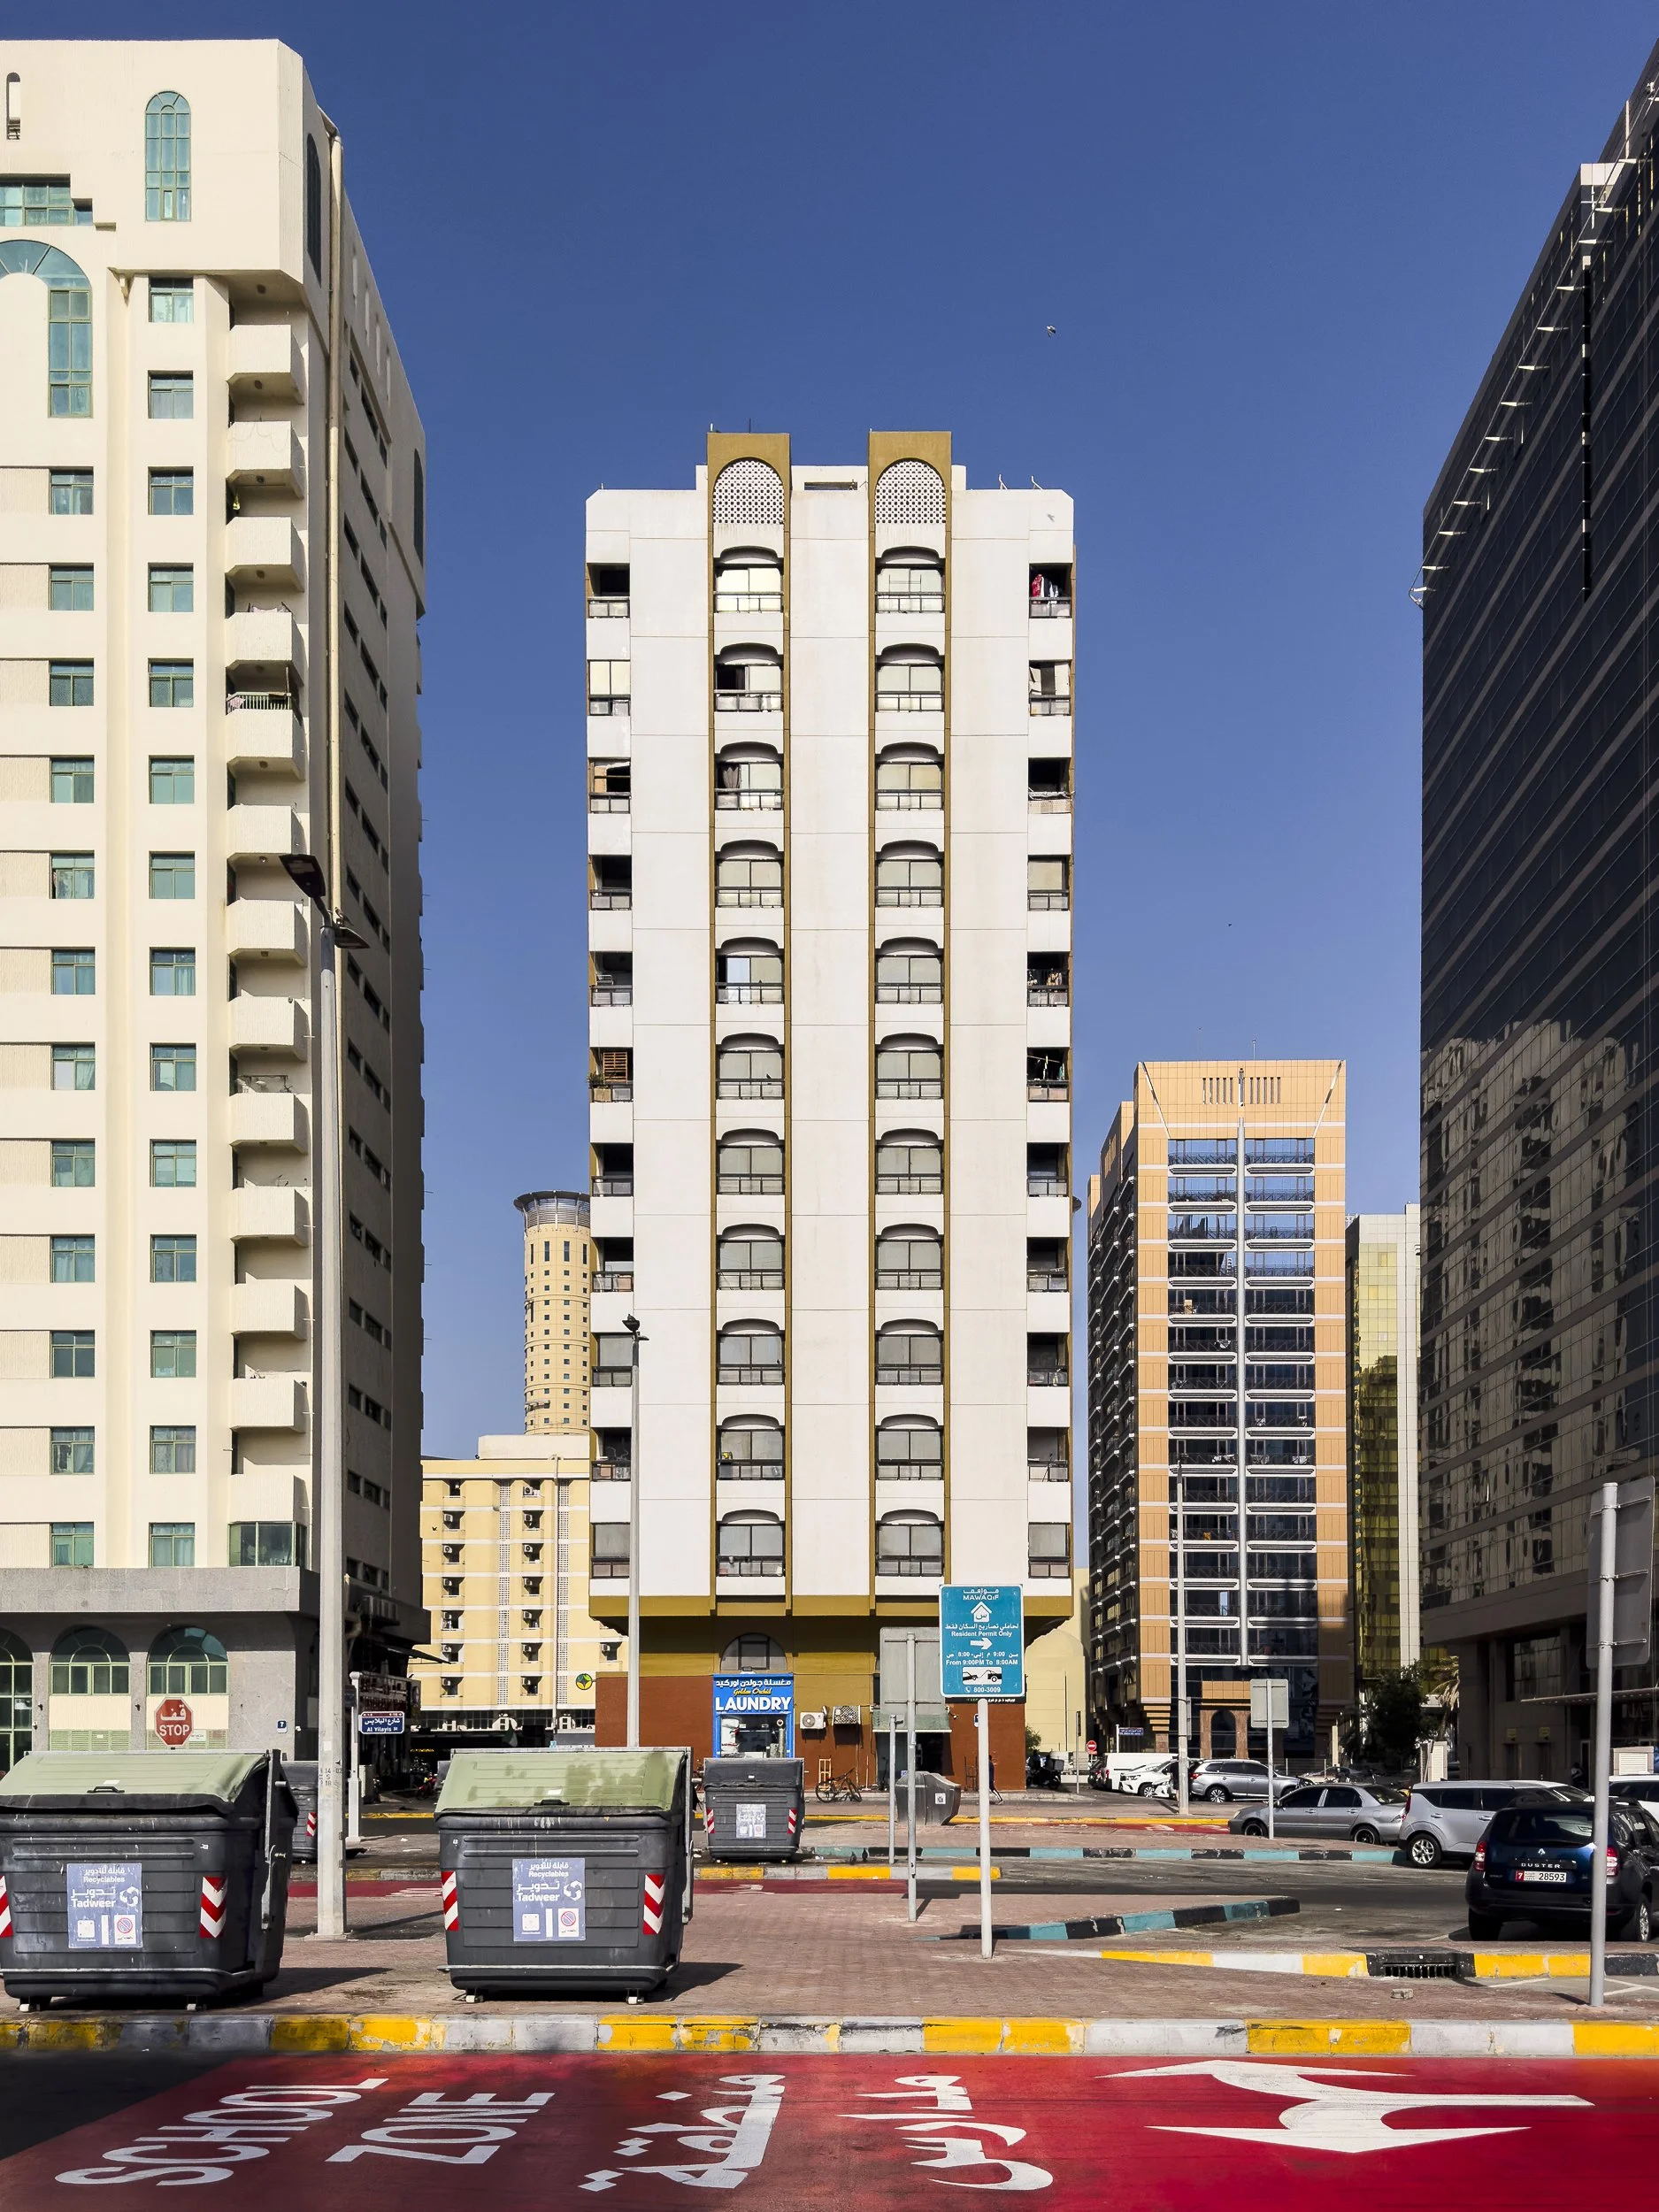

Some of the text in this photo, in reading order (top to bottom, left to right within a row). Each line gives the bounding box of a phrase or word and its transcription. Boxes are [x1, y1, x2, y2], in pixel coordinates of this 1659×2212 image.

[715, 1697, 791, 1711] LAUNDRY
[160, 1704, 186, 1720] قف
[159, 1724, 189, 1736] STOP
[71, 1885, 116, 1899] تدوير
[516, 1881, 559, 1893] تدوير
[71, 1899, 116, 1908] Tadweer
[517, 1892, 560, 1901] Tadweer
[54, 2078, 389, 2186] SCHOOL
[325, 2092, 556, 2164] ZONE
[835, 2075, 1054, 2191] مدارس
